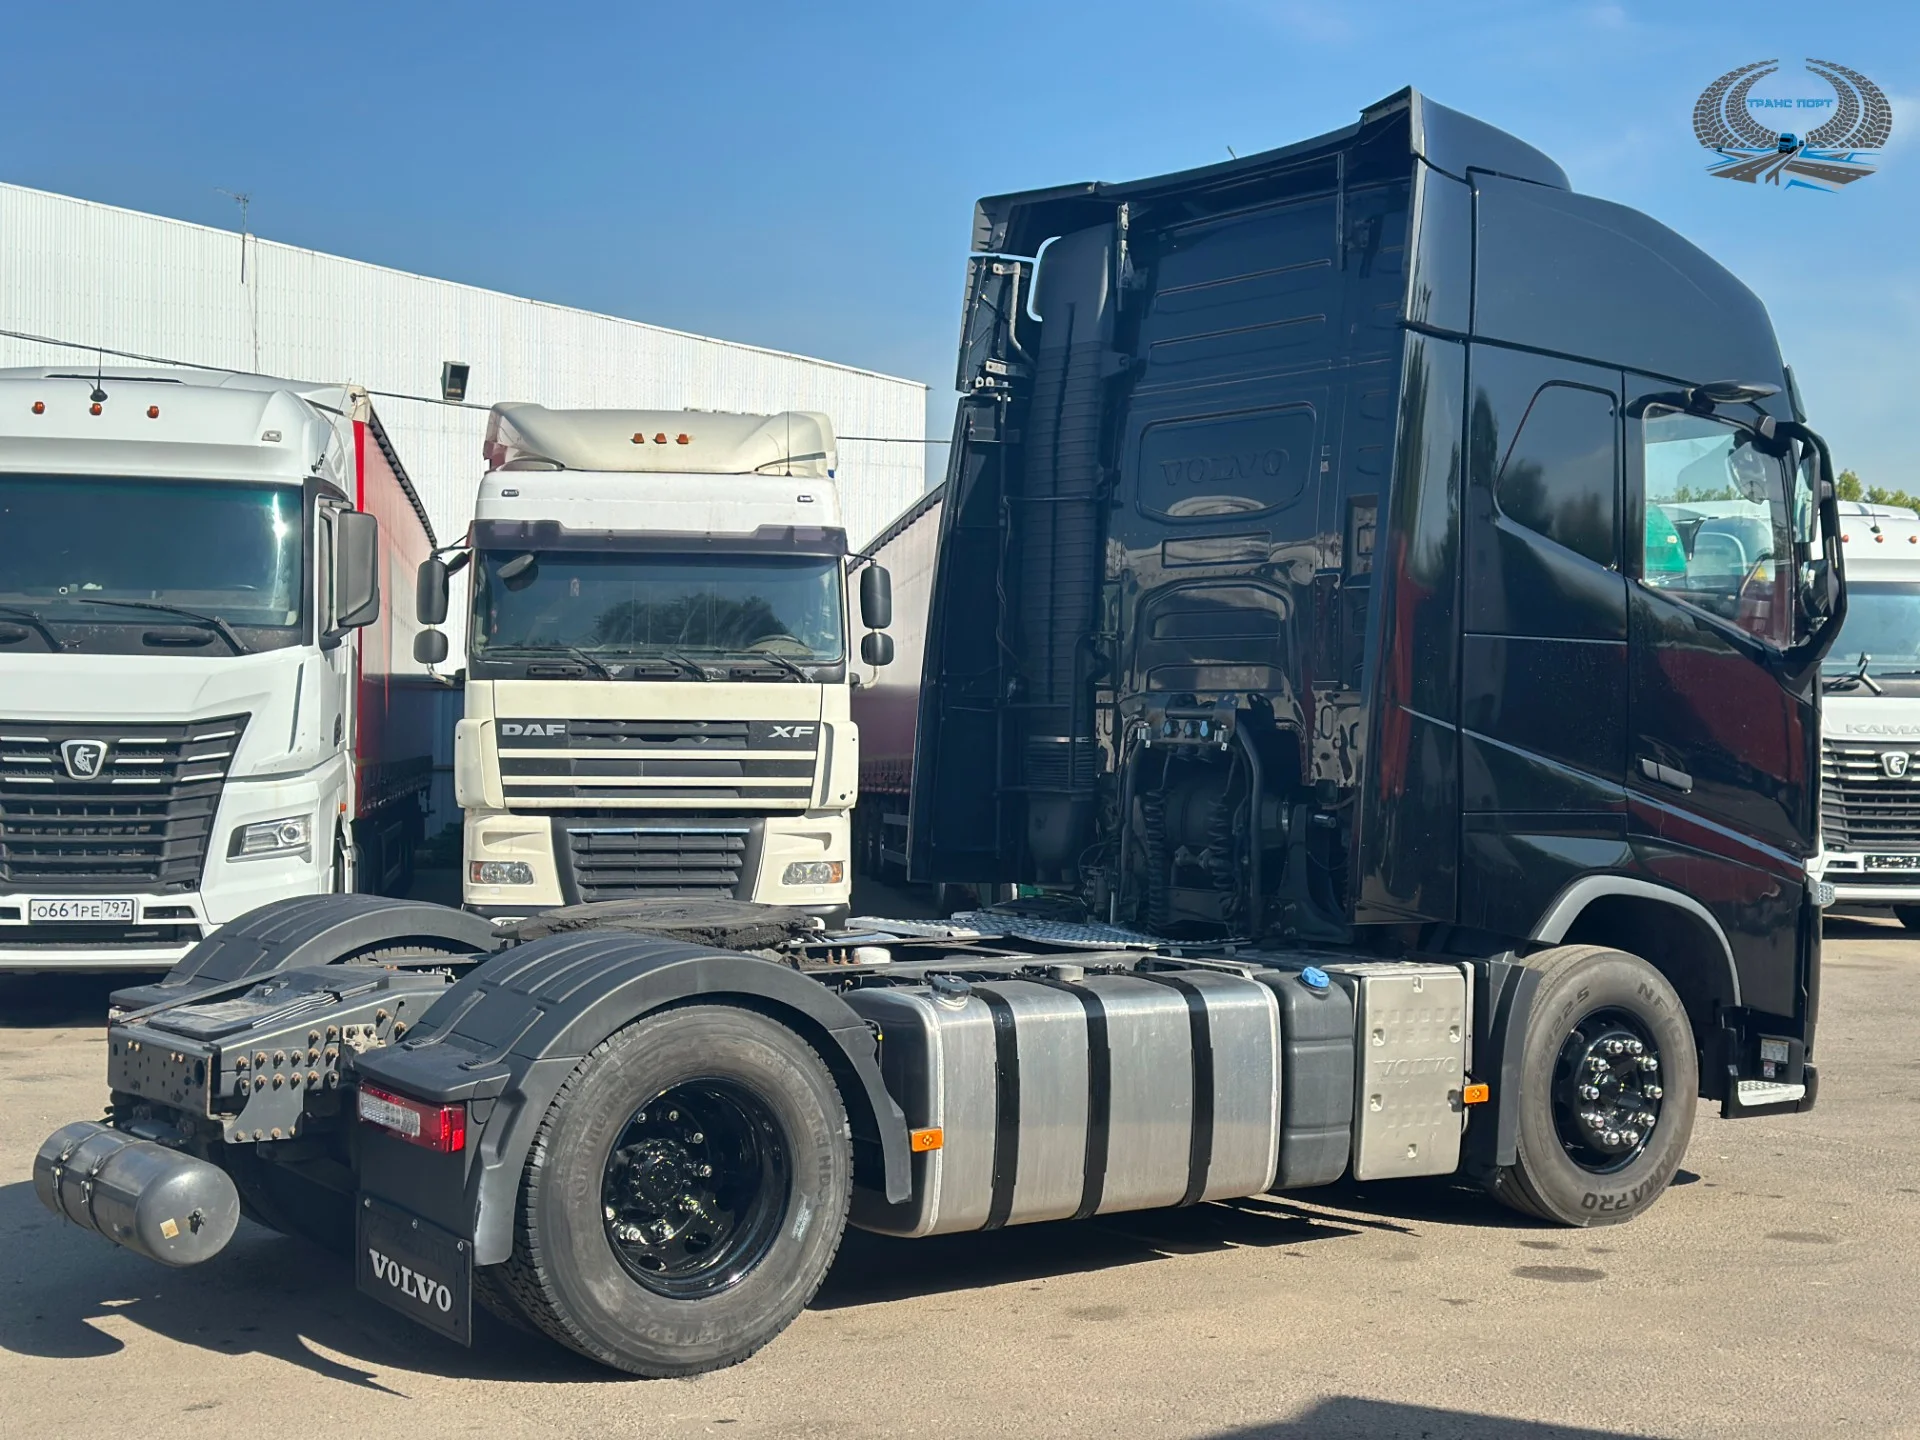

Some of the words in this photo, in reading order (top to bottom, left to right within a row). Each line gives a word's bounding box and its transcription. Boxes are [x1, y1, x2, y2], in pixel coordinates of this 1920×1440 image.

[1159, 448, 1291, 487] VOLVO
[501, 723, 566, 737] DAF
[767, 725, 816, 739] XF
[1371, 1056, 1459, 1078] VOLVO
[368, 1247, 452, 1313] VOLVO
